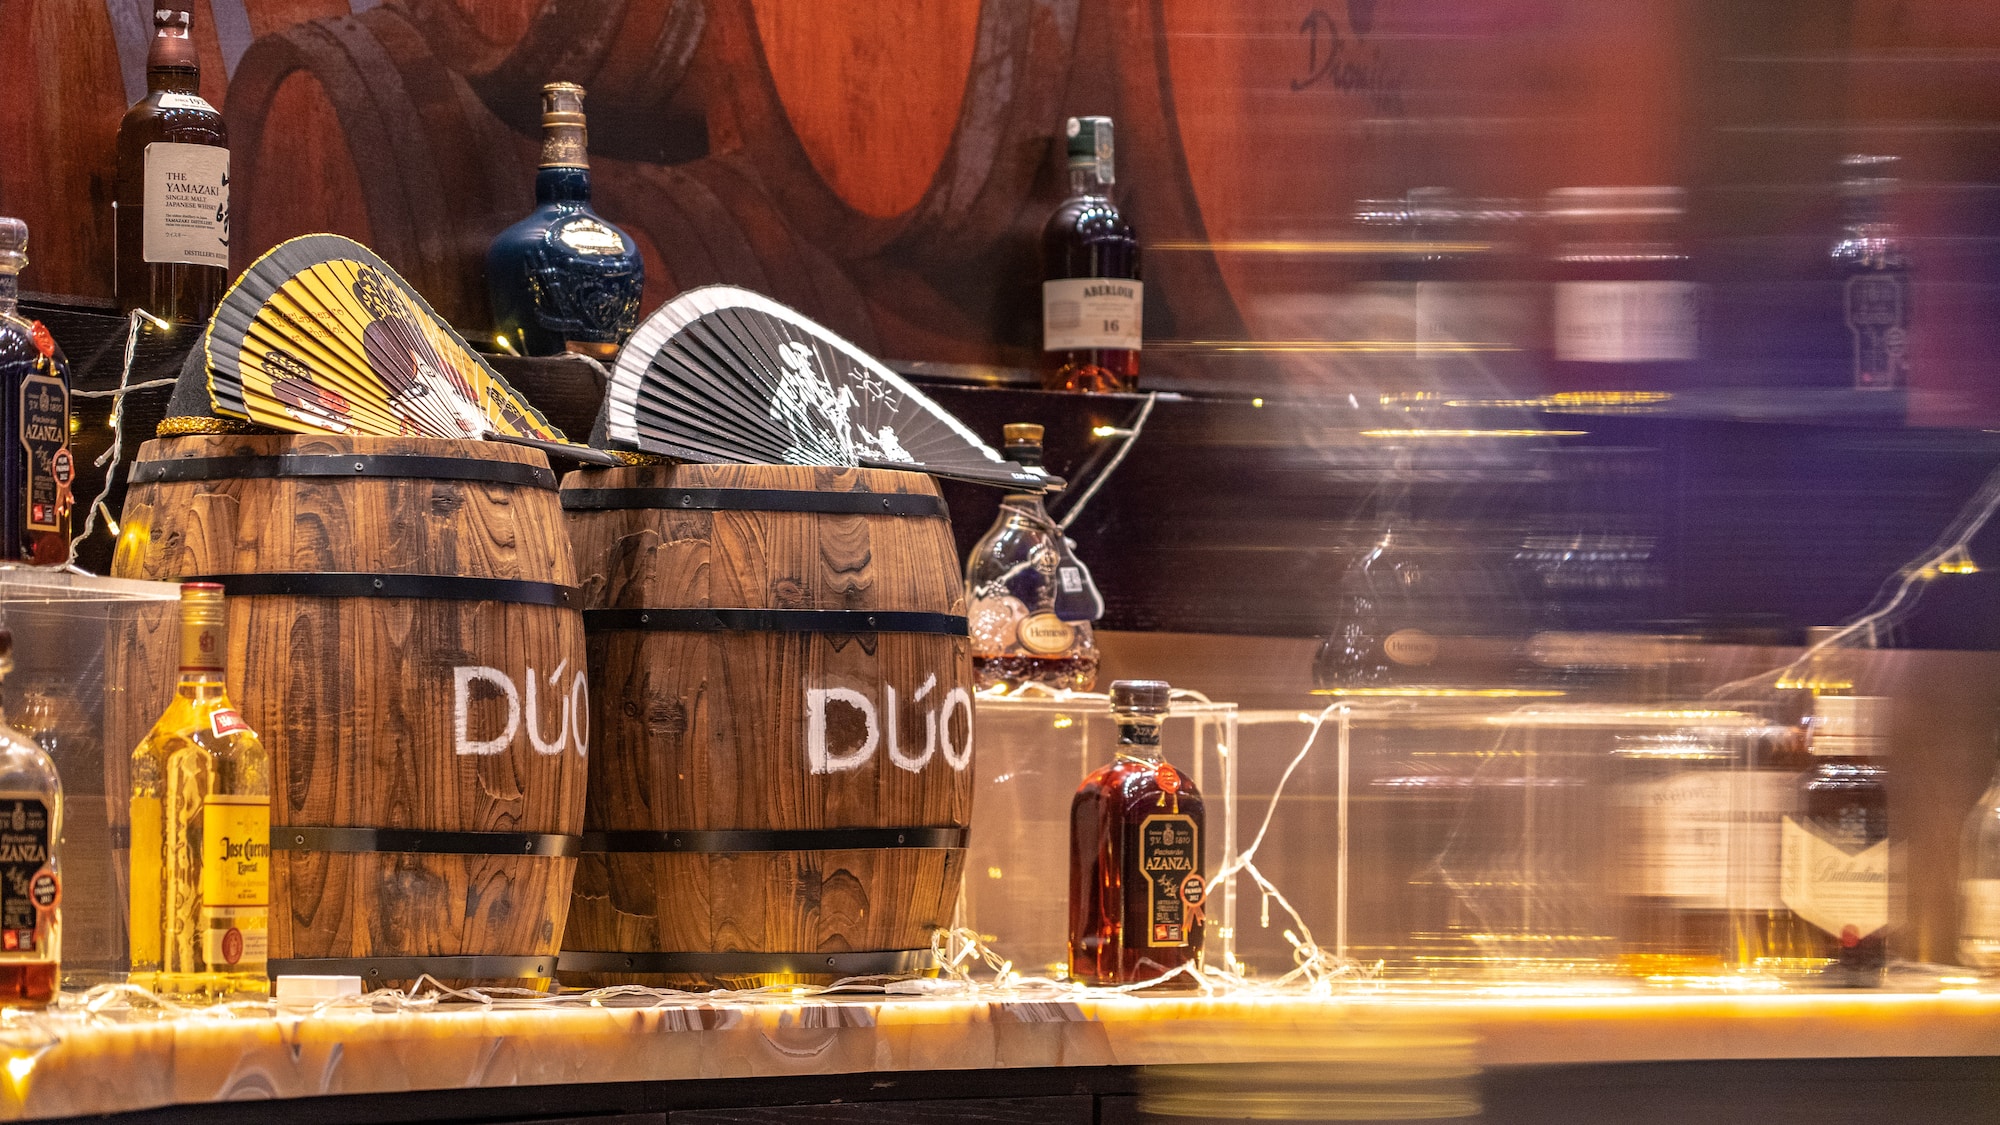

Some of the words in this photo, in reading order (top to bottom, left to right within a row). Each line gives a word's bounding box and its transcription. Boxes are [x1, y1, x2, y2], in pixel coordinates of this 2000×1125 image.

[165, 172, 188, 181] THE
[166, 182, 220, 197] YAMAZAKI
[1103, 319, 1120, 332] 16
[25, 423, 64, 443] AZANZA
[453, 658, 590, 757] DÚO
[806, 672, 973, 775] DÚO
[1145, 856, 1193, 871] AZANZA
